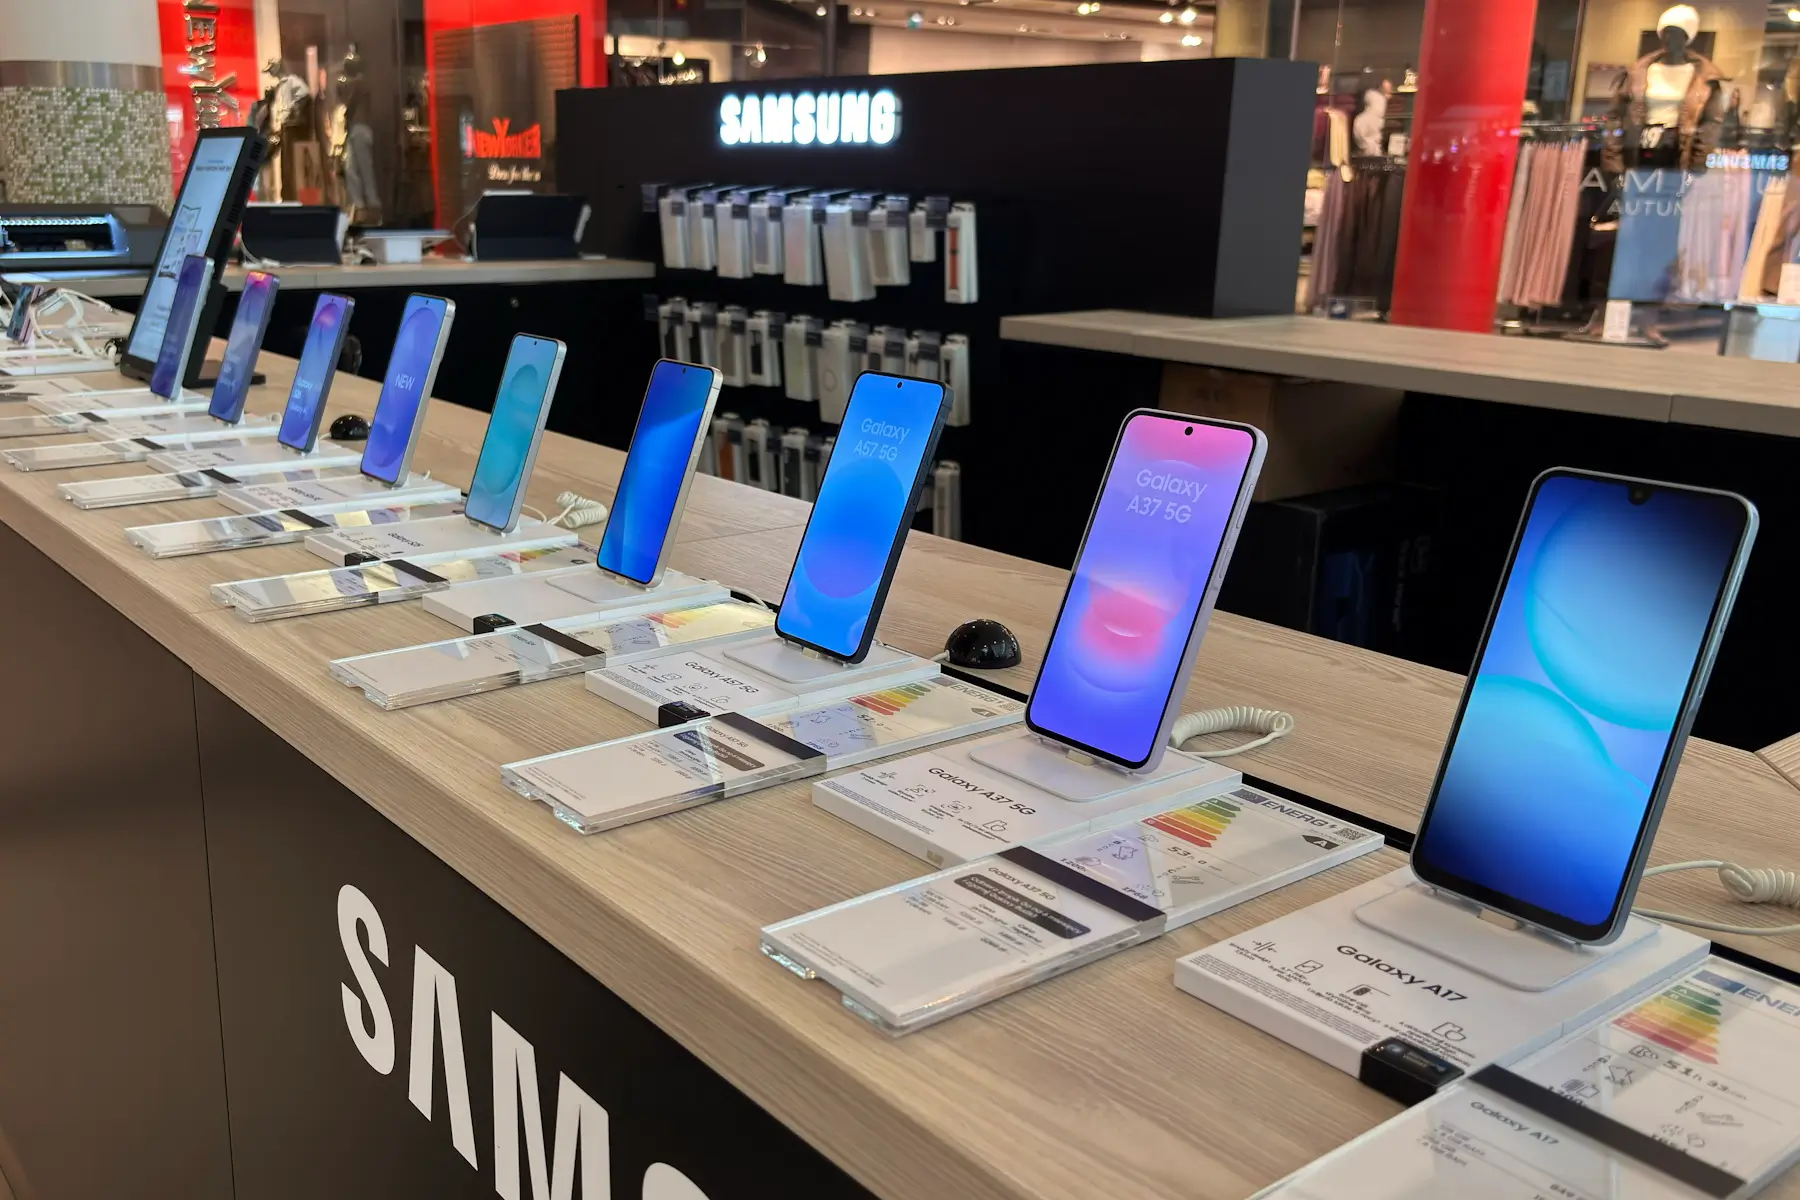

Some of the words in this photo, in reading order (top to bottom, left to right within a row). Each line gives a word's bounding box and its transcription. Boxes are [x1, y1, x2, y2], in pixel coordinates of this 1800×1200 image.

[719, 88, 901, 146] SAMSUNG
[394, 373, 416, 392] NEW
[861, 418, 910, 445] Galaxy
[852, 439, 878, 457] A57
[878, 442, 899, 462] 5G
[1136, 468, 1208, 503] Galaxy
[1126, 494, 1162, 517] A37
[1163, 501, 1192, 524] 5G
[685, 660, 725, 679] Galaxy
[719, 675, 744, 690] A57
[739, 684, 760, 694] 5G
[928, 767, 985, 793] Galaxy
[980, 788, 1015, 804] A37
[1008, 803, 1037, 816] 5G
[1261, 799, 1329, 827] ENERG
[988, 866, 1025, 888] Galaxy
[1021, 881, 1043, 894] A37
[1336, 945, 1427, 986] Galaxy
[1421, 984, 1469, 1002] A17
[337, 884, 711, 1200] SAM
[1469, 1100, 1530, 1132] Galaxy
[1528, 1130, 1560, 1145] A17
